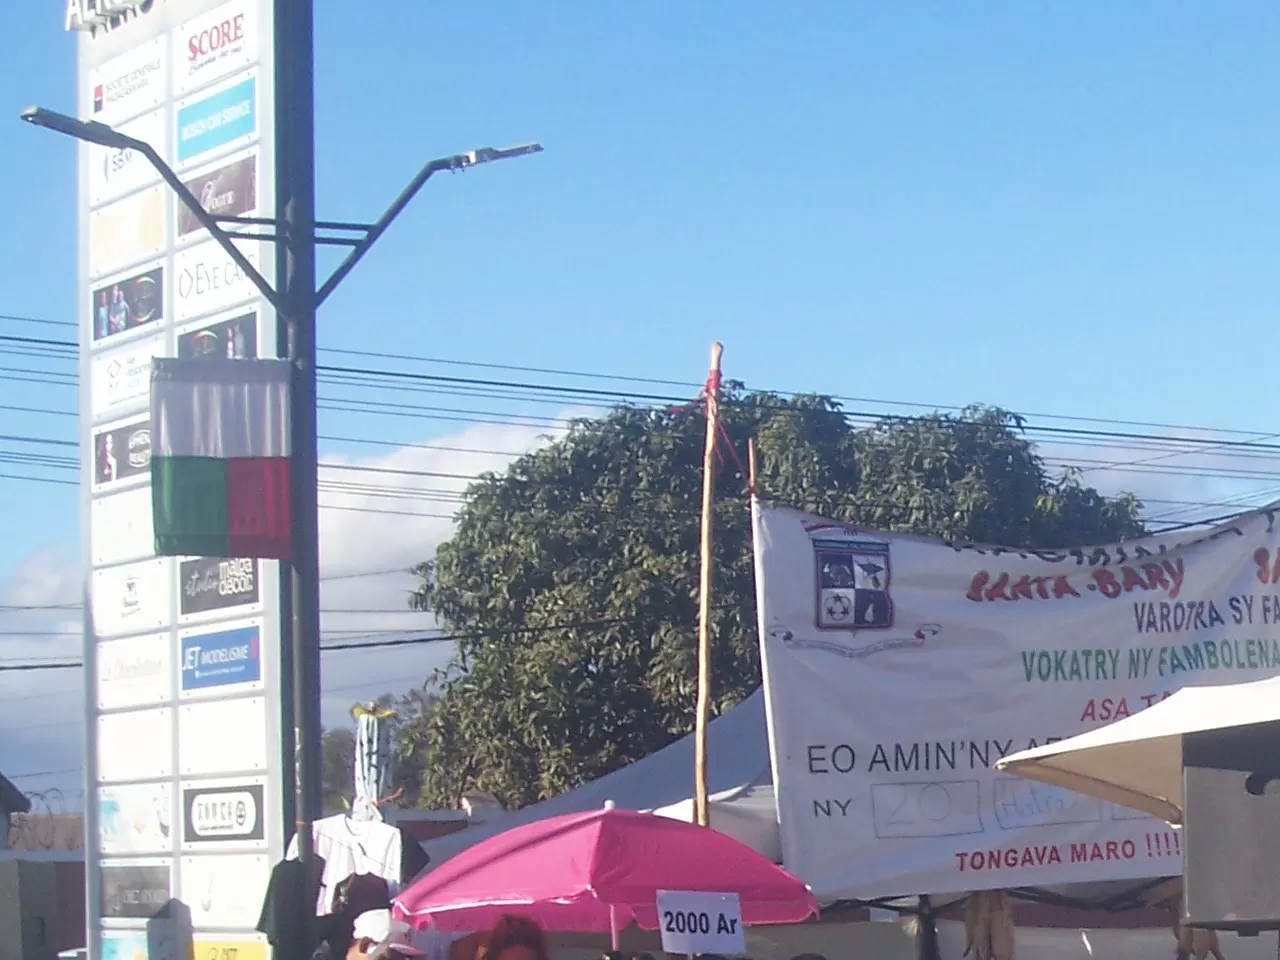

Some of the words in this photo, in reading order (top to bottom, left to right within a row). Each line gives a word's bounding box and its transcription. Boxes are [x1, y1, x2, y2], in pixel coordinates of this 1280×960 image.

[187, 12, 245, 62] SCORE
[195, 262, 220, 295] EYE
[1133, 599, 1225, 633] VAROTRA
[1229, 595, 1254, 625] SY
[1022, 648, 1120, 682] VOKATRY
[1127, 647, 1153, 680] NY
[1080, 698, 1131, 722] ASA
[806, 744, 856, 773] EO
[867, 738, 1014, 773] AMIN'NY
[812, 799, 853, 818] NY
[955, 846, 1062, 872] TONGAVA
[1069, 839, 1137, 865] MARO
[663, 910, 710, 935] 2000
[717, 912, 738, 935] Ar
